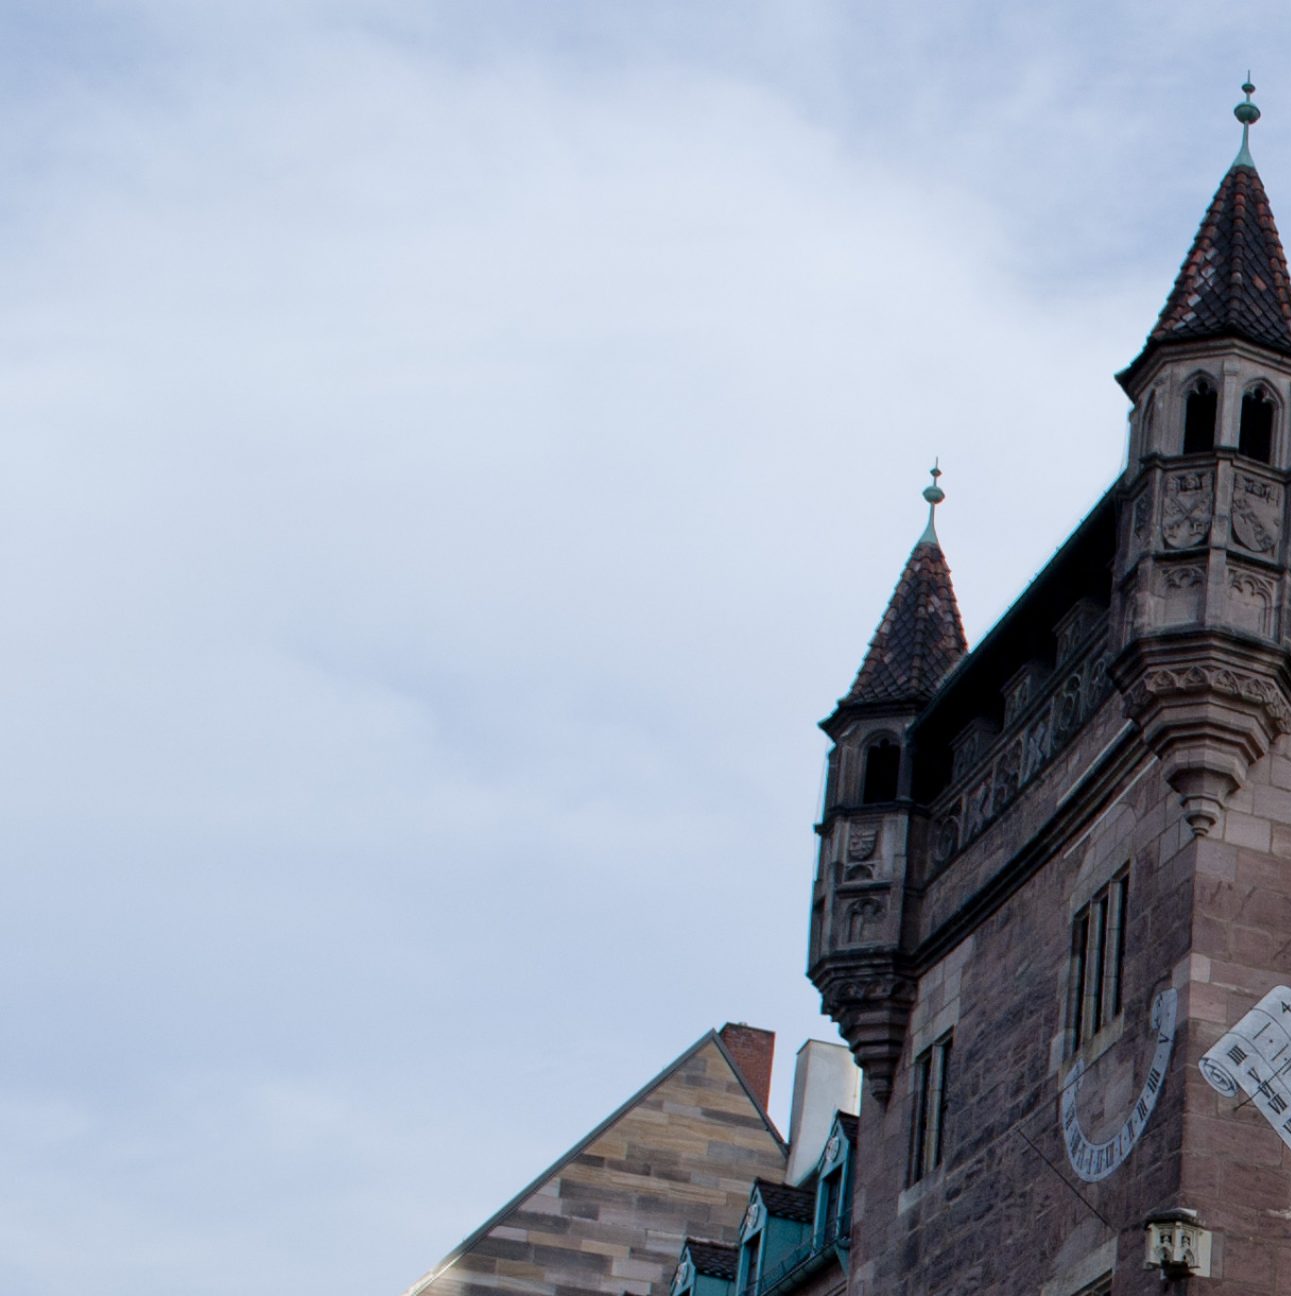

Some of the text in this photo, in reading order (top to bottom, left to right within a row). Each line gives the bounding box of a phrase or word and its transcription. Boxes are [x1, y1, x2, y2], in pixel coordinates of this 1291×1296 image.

[1280, 1001, 1291, 1013] 4
[1227, 1045, 1248, 1066] IIII
[1247, 1067, 1262, 1081] V
